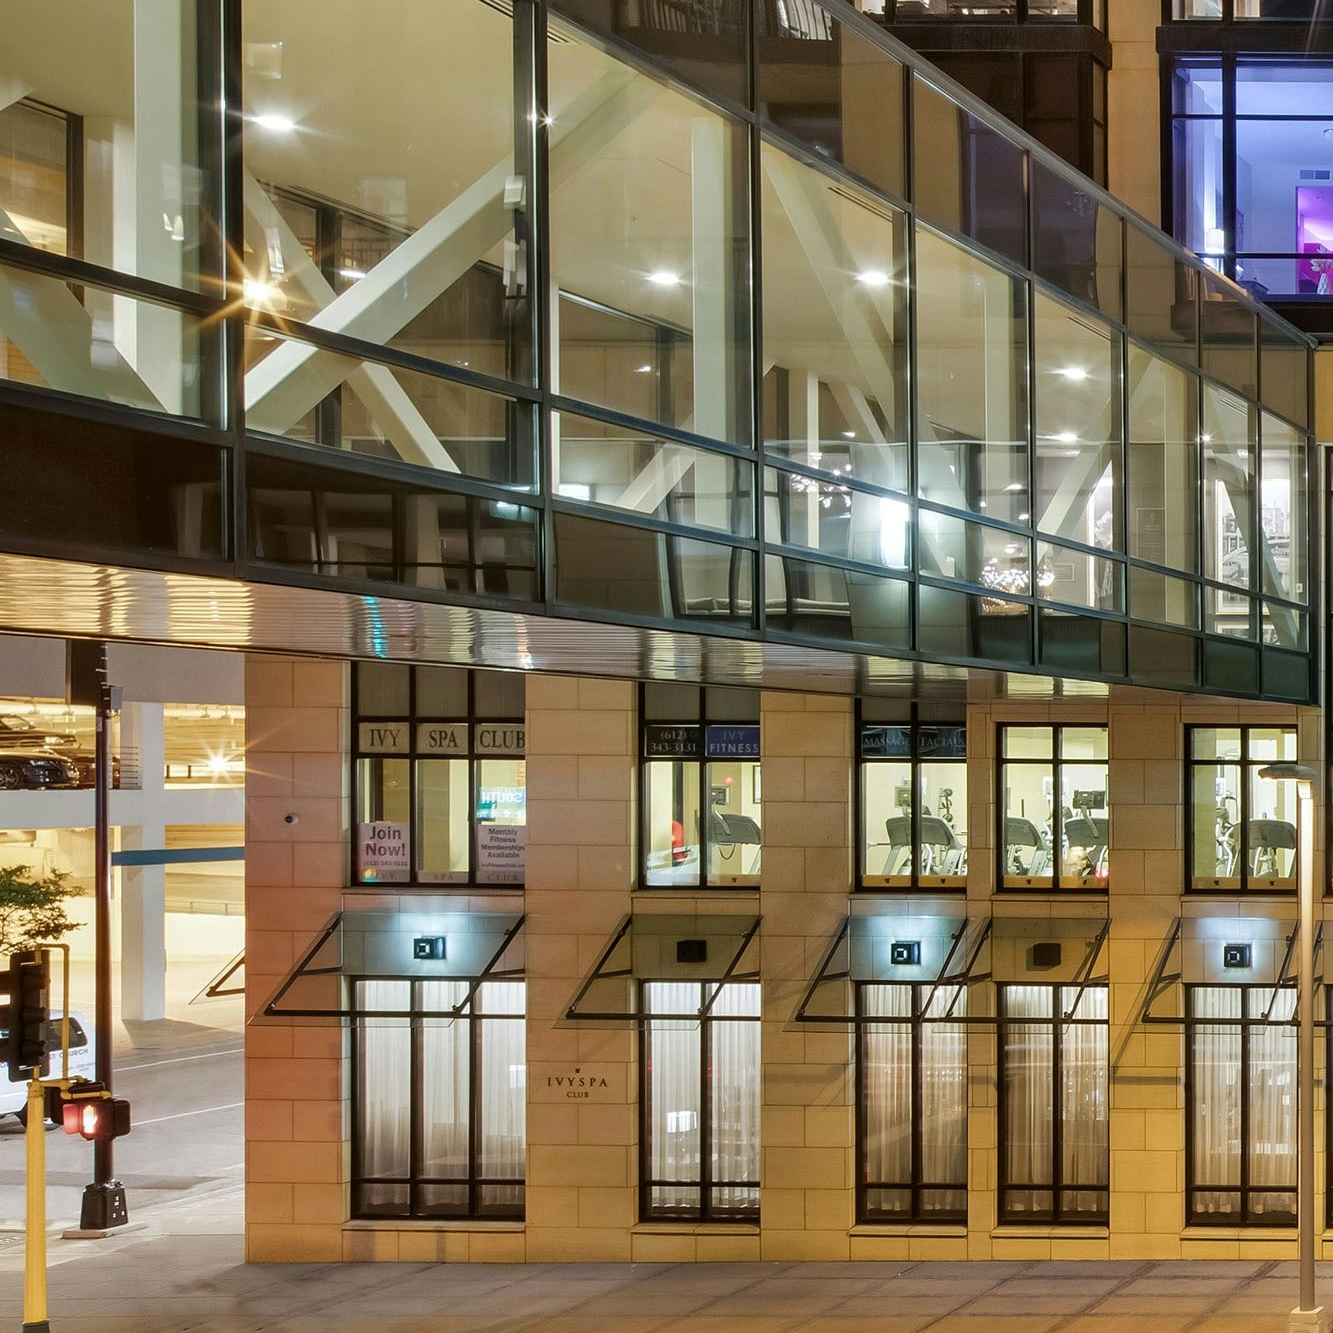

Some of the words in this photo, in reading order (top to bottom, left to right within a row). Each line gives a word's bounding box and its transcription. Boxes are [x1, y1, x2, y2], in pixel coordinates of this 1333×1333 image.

[370, 729, 400, 746] IVY
[429, 730, 458, 748] SPA
[480, 730, 525, 748] CLUB
[661, 730, 686, 740] (612)
[723, 730, 745, 740] IVY
[864, 737, 909, 746] MASSAGE
[921, 738, 965, 746] FACIALS
[650, 743, 696, 752] 343-3131
[709, 743, 759, 753] FITNESS
[369, 826, 401, 840] Join
[488, 828, 518, 837] Monthly
[366, 842, 406, 856] Now!
[481, 844, 525, 852] Memberships
[58, 1048, 89, 1059] CURCH
